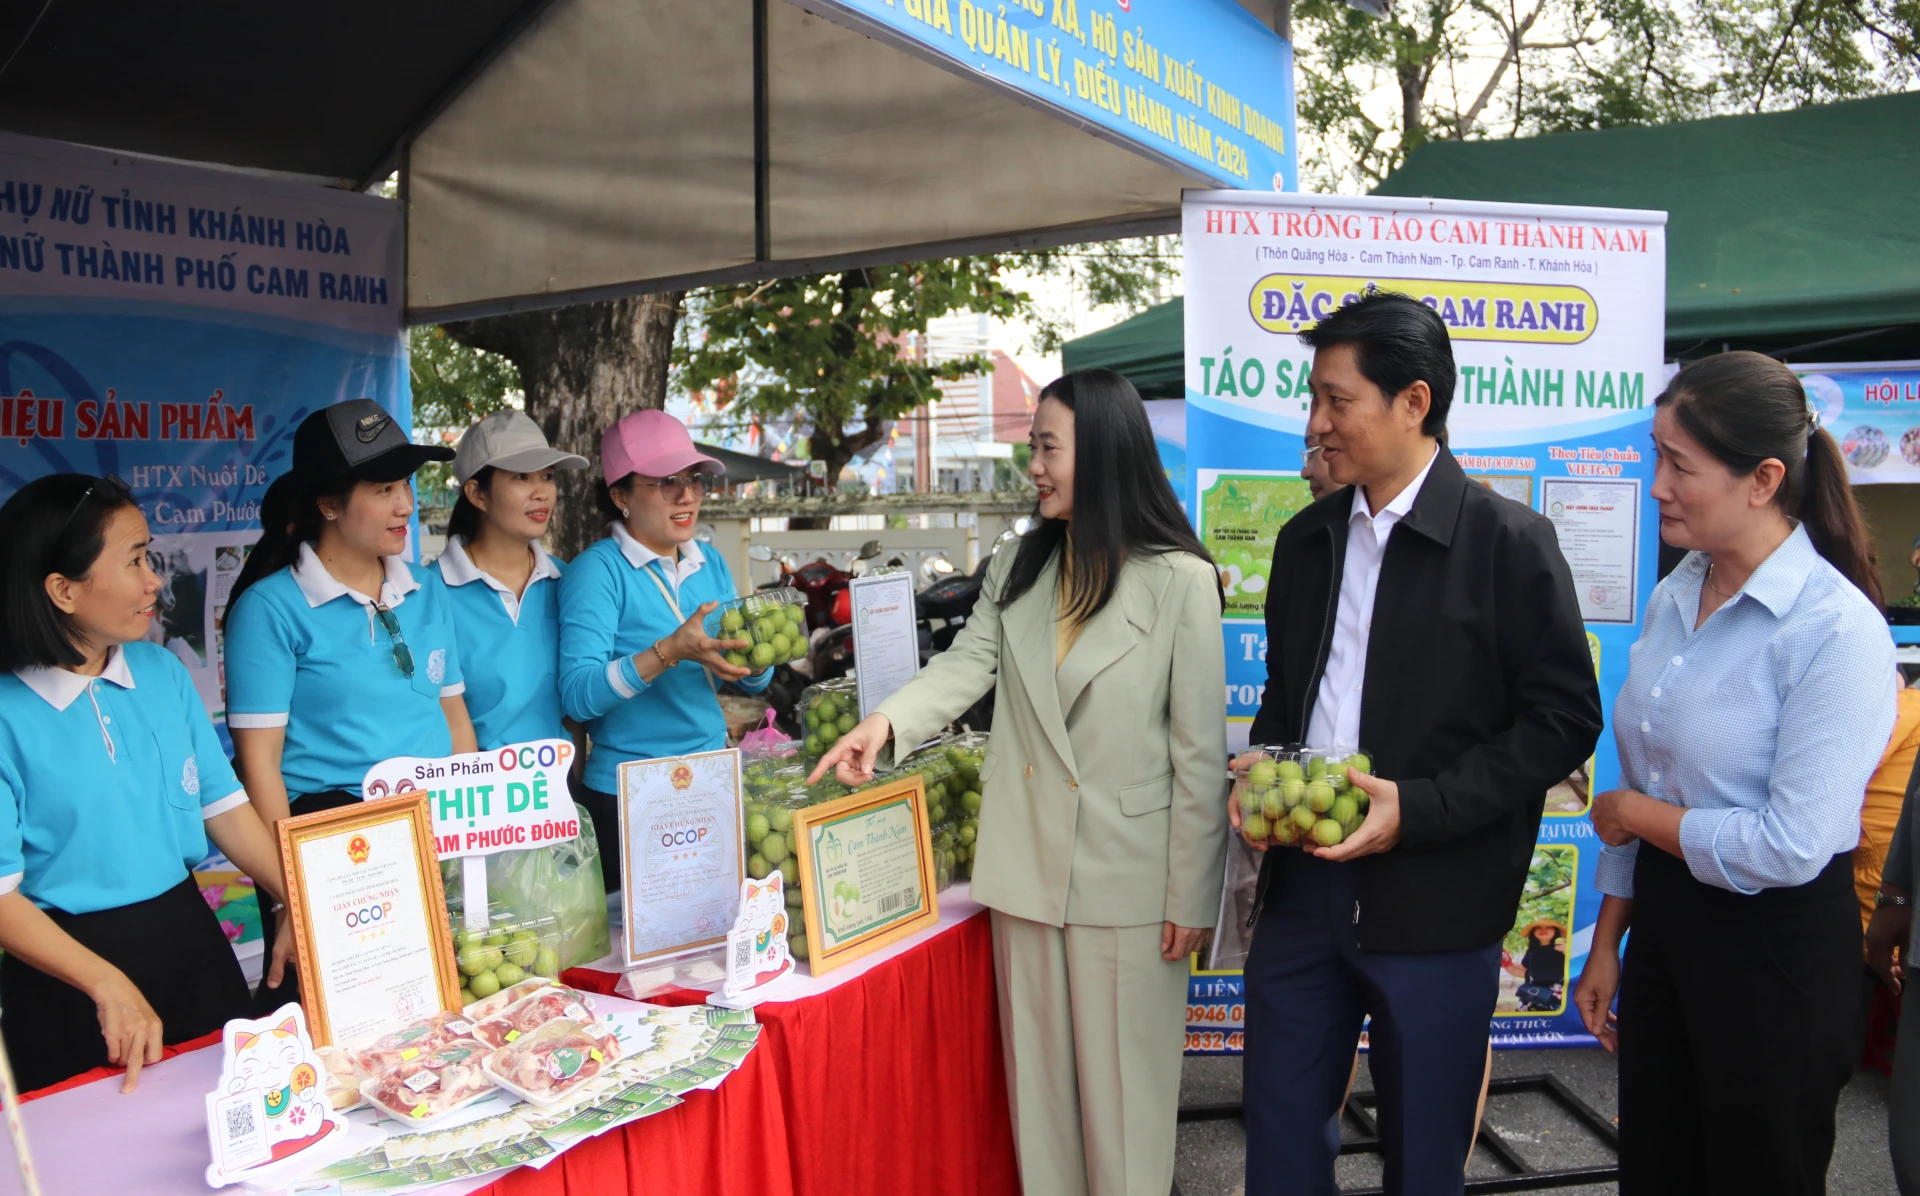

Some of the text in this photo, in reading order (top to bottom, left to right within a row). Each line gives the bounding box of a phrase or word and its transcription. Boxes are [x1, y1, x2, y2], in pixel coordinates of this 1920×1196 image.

[959, 0, 1030, 73] QUẢN
[1074, 58, 1122, 116] ĐIỀU
[1125, 84, 1176, 144] HÀNH
[1176, 112, 1215, 163] NĂM
[1216, 135, 1250, 181] 2024
[1091, 10, 1118, 67] HỘ
[1123, 26, 1160, 84] SẢN
[1163, 59, 1204, 109] XUẤT
[1207, 81, 1242, 130] KINH
[1244, 104, 1285, 156] DOANH
[0, 180, 351, 256] HỤ NỮ TỈNH KHÁNH HÒA
[1205, 207, 1648, 253] HTX TRỒNG TÁO CAM THÀNH NAM
[0, 231, 388, 305] NỮ THÀNH PHỐ CAM RANH
[1262, 246, 1288, 260] Thôn
[1328, 249, 1348, 262] Hòa
[1360, 251, 1382, 264] Cam
[1385, 251, 1417, 265] Thành
[1420, 252, 1442, 266] Nam
[1451, 254, 1466, 270] Tp.
[1469, 255, 1491, 269] Cam
[1494, 256, 1519, 270] Ranh
[1539, 258, 1570, 273] Khánh
[1573, 260, 1592, 273] Hòa
[1263, 282, 1332, 330] ĐẶC
[1496, 301, 1586, 332] RANH
[1200, 345, 1645, 411] TÁO SẠ THÀNH NAM
[1866, 379, 1898, 405] HỘI
[0, 388, 257, 448] IỆU SẢN PHẨM
[360, 414, 381, 426] NIKE
[1549, 447, 1577, 459] Theo
[1580, 448, 1602, 460] Tiêu
[132, 464, 267, 488] HTX Nuôi Dê
[1567, 463, 1622, 476] VIETGAP
[154, 502, 206, 525] Cam
[1240, 633, 1267, 661] Tá
[415, 744, 572, 780] Sản Phẩm OCOP
[507, 770, 549, 813] DÊ
[434, 819, 578, 854] AM PHƯỚC ĐÔNG
[662, 827, 707, 848] OCOP
[1539, 821, 1594, 841] TẠI VƯỜN
[346, 901, 392, 928] OCOP
[1194, 978, 1240, 998] LIÊN
[1186, 1005, 1244, 1022] 0946 0
